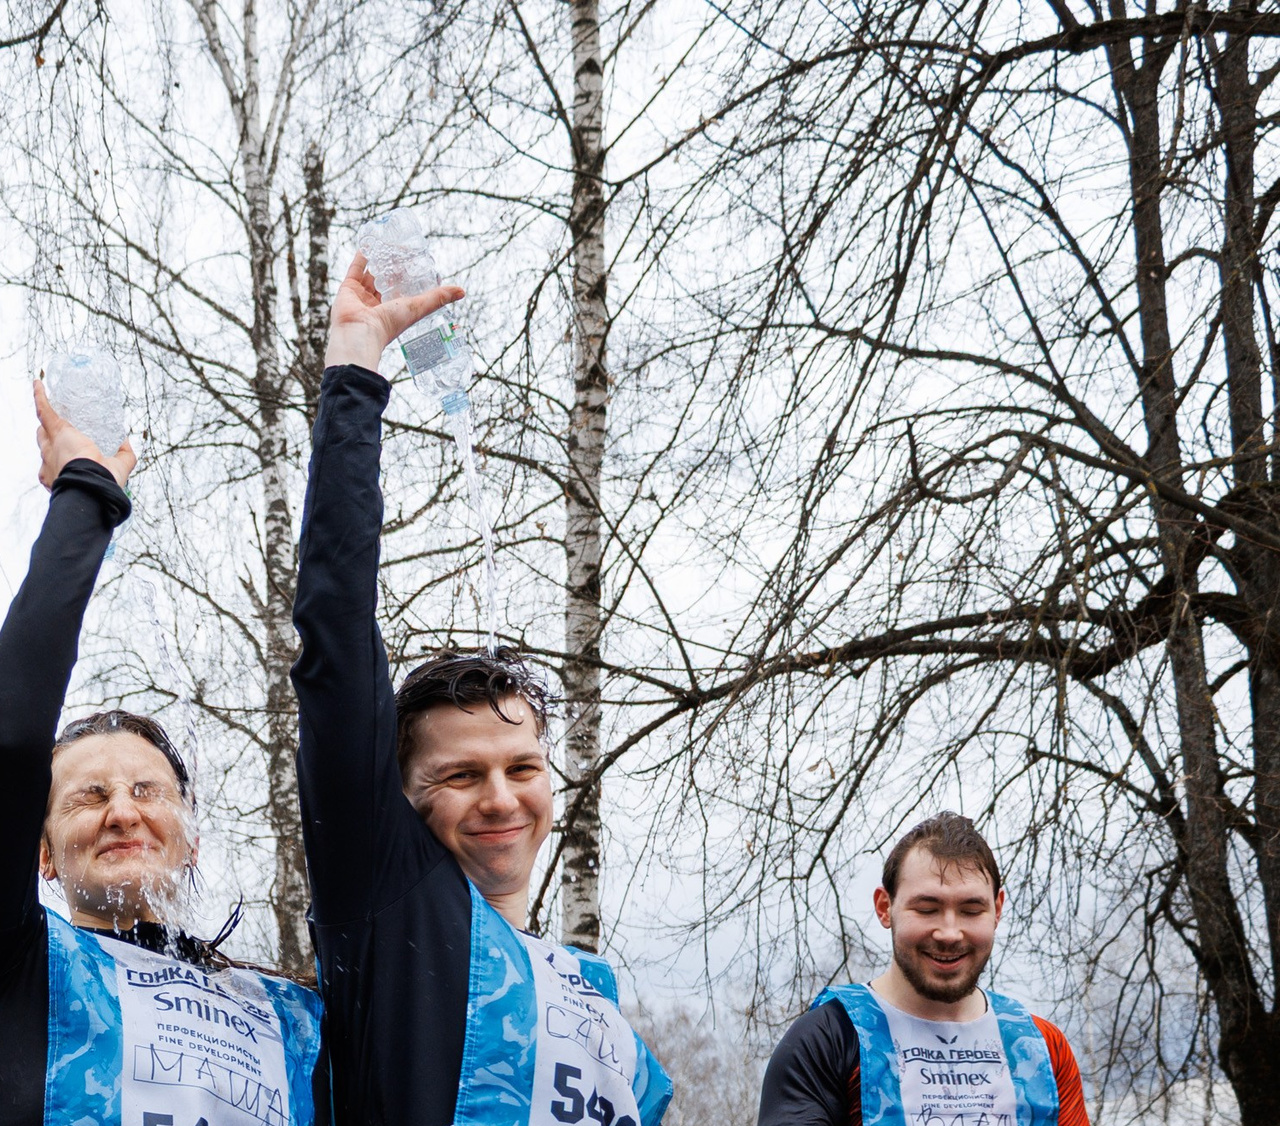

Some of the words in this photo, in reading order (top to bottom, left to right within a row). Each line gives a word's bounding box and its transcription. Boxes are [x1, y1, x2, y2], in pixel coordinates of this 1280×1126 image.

[126, 967, 199, 984] ГОНКА
[153, 992, 258, 1044] Sminex
[157, 1022, 261, 1066] ПЕРФЕКЦИОНИСТЫ
[158, 1035, 184, 1046] FINE
[188, 1042, 262, 1077] DEVELOPMENT
[903, 1047, 946, 1060] ГОНКА
[949, 1049, 1000, 1060] ГЕРОЕВ
[920, 1067, 991, 1086] Sminex
